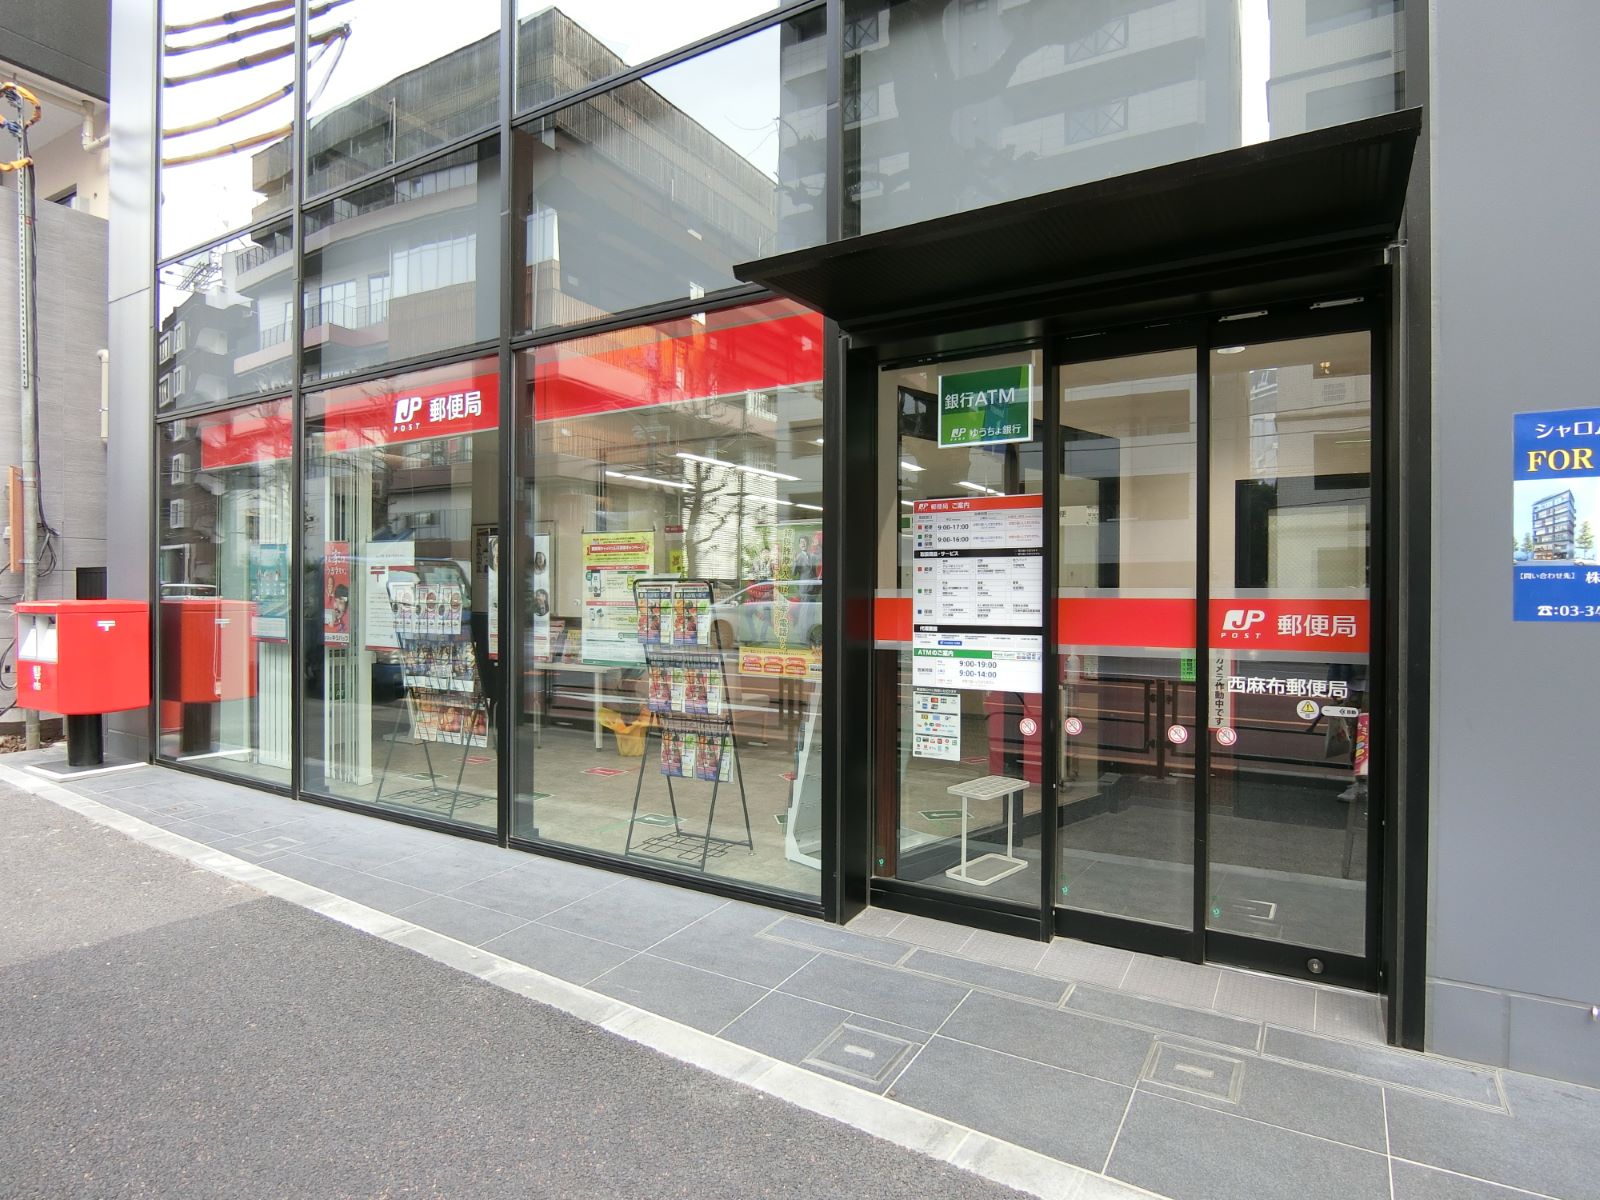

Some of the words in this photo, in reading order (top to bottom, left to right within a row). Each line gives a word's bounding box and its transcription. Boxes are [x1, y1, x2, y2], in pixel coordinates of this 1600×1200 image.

[429, 391, 482, 422] 郵便局
[945, 387, 1015, 410] 銀行ATM
[393, 422, 421, 433] POST
[969, 424, 1022, 438] ゆうちょ銀行
[1527, 448, 1595, 472] FOR
[1277, 614, 1357, 638] 郵便局
[959, 661, 997, 669] 9:00-19:00
[959, 670, 997, 678] 9:00-14:00
[1227, 676, 1349, 699] 西麻布郵便局
